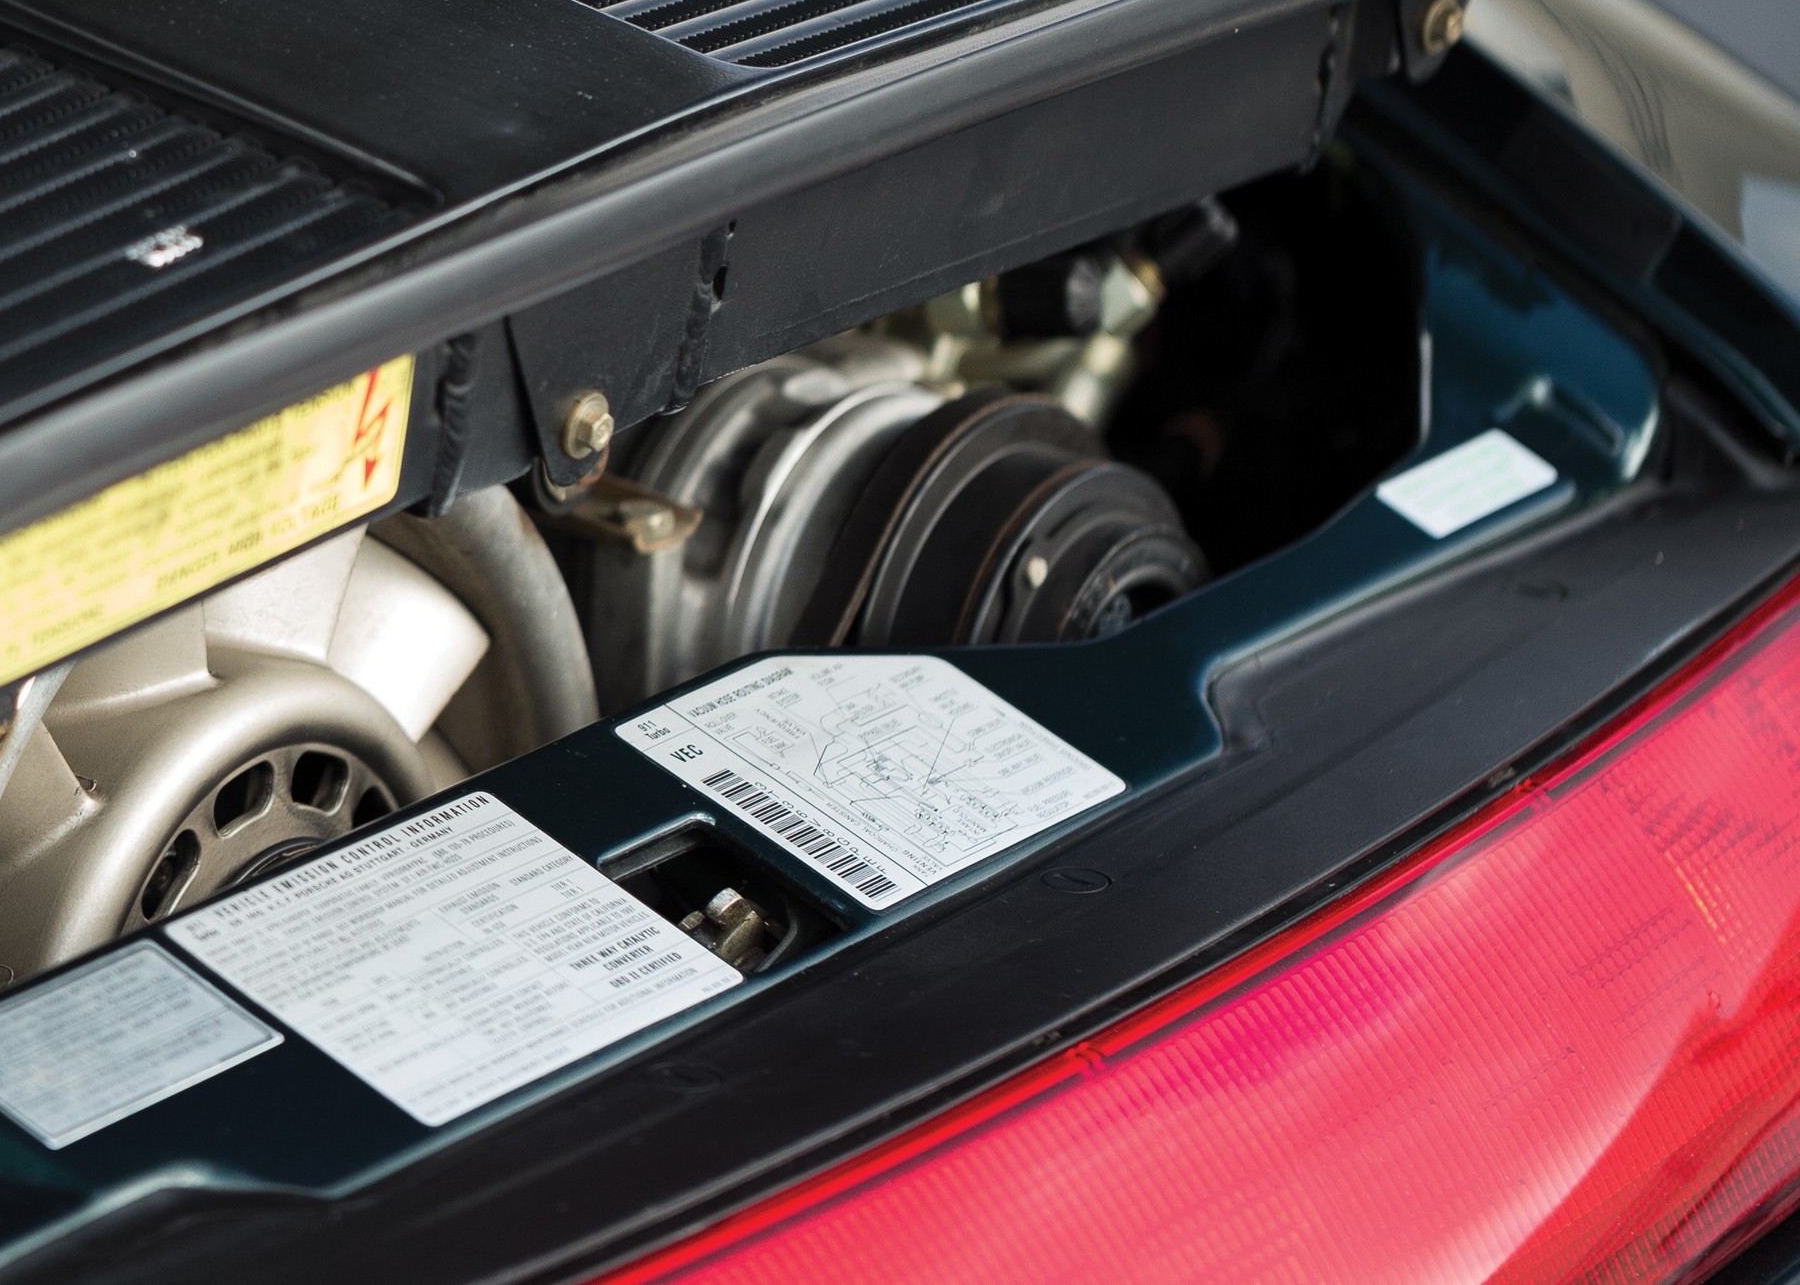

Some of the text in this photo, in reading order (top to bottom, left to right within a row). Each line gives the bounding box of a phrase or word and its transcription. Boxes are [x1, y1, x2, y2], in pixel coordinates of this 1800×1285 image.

[685, 665, 795, 718] VACUUM HOSE ROUTING DIAGRAM
[774, 691, 802, 707] SYSTEM
[636, 719, 657, 731] 911
[643, 725, 672, 740] Turbo
[668, 743, 705, 764] VEC
[467, 818, 516, 843] PROCEDURES)
[825, 801, 899, 852] CHARCOAL CANISTER
[951, 807, 988, 832] MANIFOLD
[957, 819, 981, 835] INTAKE
[212, 794, 491, 918] VEHICLE EMISSION CONTROL INFORMATION
[293, 876, 339, 899] PORSCHE
[351, 847, 406, 873] STUTTGART
[408, 825, 455, 848] GERMANY
[410, 885, 430, 897] FOR
[424, 871, 461, 890] DETAILED
[454, 854, 501, 877] ADJUSTMENT
[495, 835, 544, 860] INSTRUCTIONS
[901, 849, 938, 874] VENTING
[921, 855, 944, 870] VALVE
[508, 854, 576, 886] STANDARD CATEGORY
[911, 864, 930, 877] TANK
[464, 881, 502, 900] EMISSION
[549, 880, 569, 891] TIER
[560, 887, 579, 898] TIER
[510, 896, 601, 940] THIS VEHICLE CONFORMS TO
[548, 924, 567, 935] AND
[562, 916, 584, 929] STATE
[580, 912, 593, 920] OF
[588, 896, 629, 917] CALIFORNIA
[532, 931, 580, 955] REGULATIONS
[575, 915, 614, 936] APPLICABLE
[610, 911, 623, 919] TO
[565, 941, 586, 953] YEAR
[581, 933, 602, 945] NEW
[595, 923, 623, 938] MOTOR
[616, 910, 651, 929] VEHICLES
[568, 925, 661, 971] THREE WAY CATALYTIC
[601, 944, 654, 971] CONVERTER
[608, 951, 683, 988] OBD II CERTIFIED
[651, 966, 699, 991] INFORMATION
